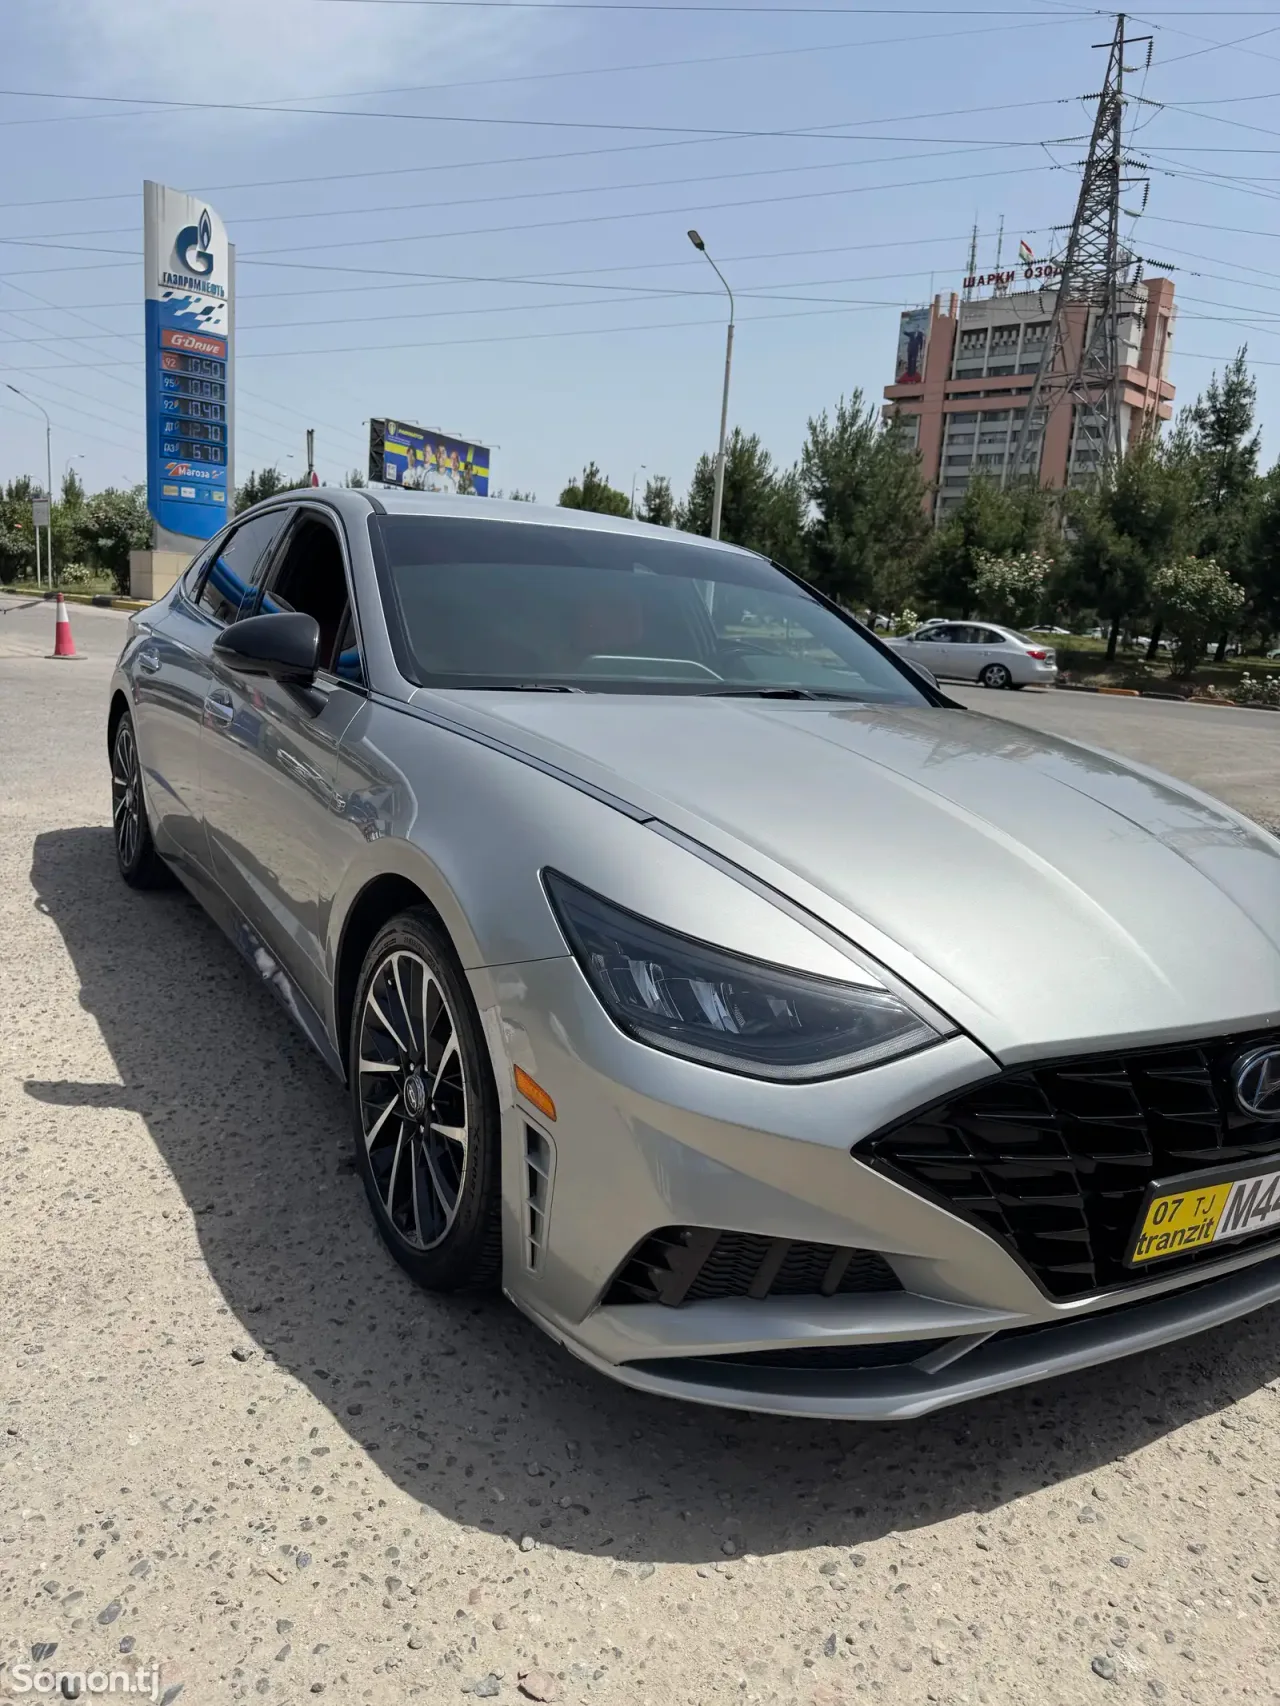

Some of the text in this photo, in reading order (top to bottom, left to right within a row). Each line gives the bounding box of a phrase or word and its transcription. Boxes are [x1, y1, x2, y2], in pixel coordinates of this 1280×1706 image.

[163, 272, 225, 297] ГАЗПРОМНЕФТЬ
[165, 357, 176, 368] 92
[164, 377, 175, 388] 95
[163, 399, 221, 420] 92 10.40
[1152, 1194, 1216, 1226] 07 TJ
[1136, 1216, 1214, 1256] tranzit
